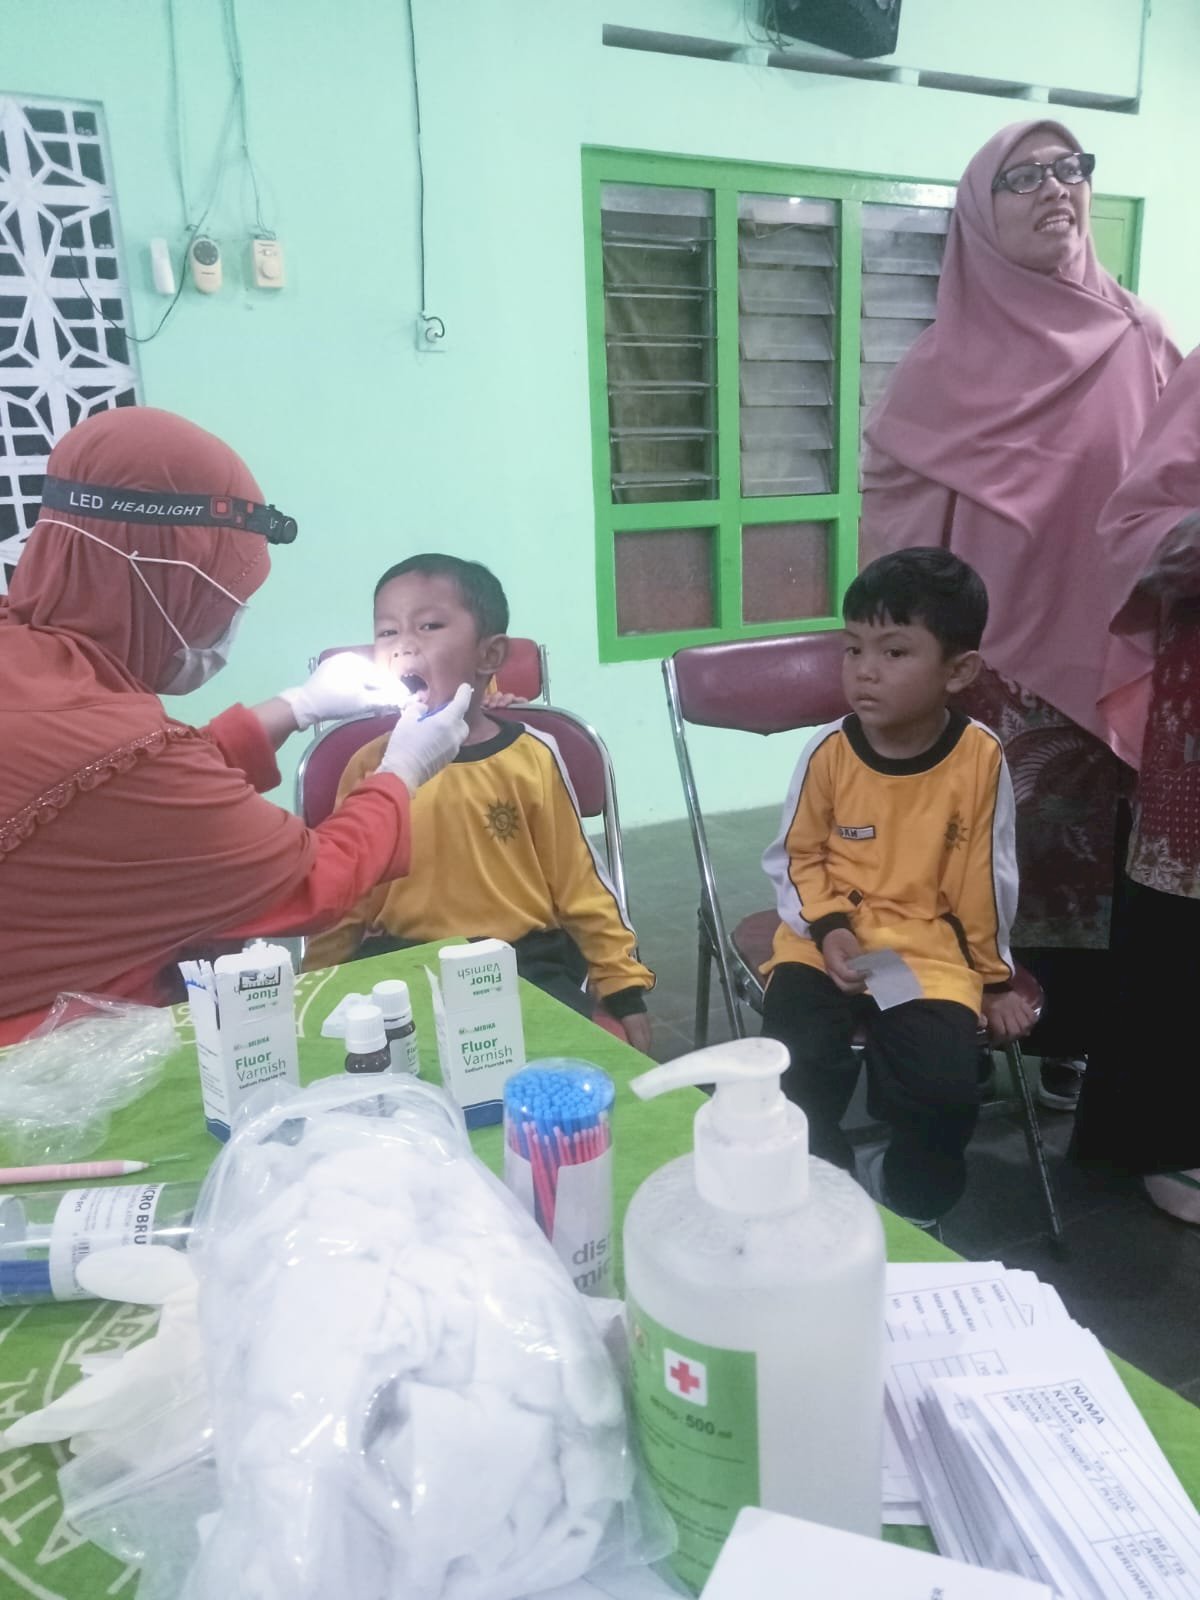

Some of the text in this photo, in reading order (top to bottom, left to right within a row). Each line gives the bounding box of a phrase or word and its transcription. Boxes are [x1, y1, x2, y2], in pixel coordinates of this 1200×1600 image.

[69, 491, 205, 516] LED HEADLIGHT
[457, 962, 501, 980] Varnish
[470, 972, 502, 986] Fluor
[246, 987, 279, 1002] Fluor
[461, 1037, 498, 1055] Fluor
[463, 1045, 513, 1067] Varnish
[235, 1051, 272, 1071] Fluor
[236, 1058, 287, 1082] Varnish
[1053, 1389, 1086, 1425] KELAS
[1071, 1385, 1105, 1425] NAMA
[685, 1413, 716, 1436] 500
